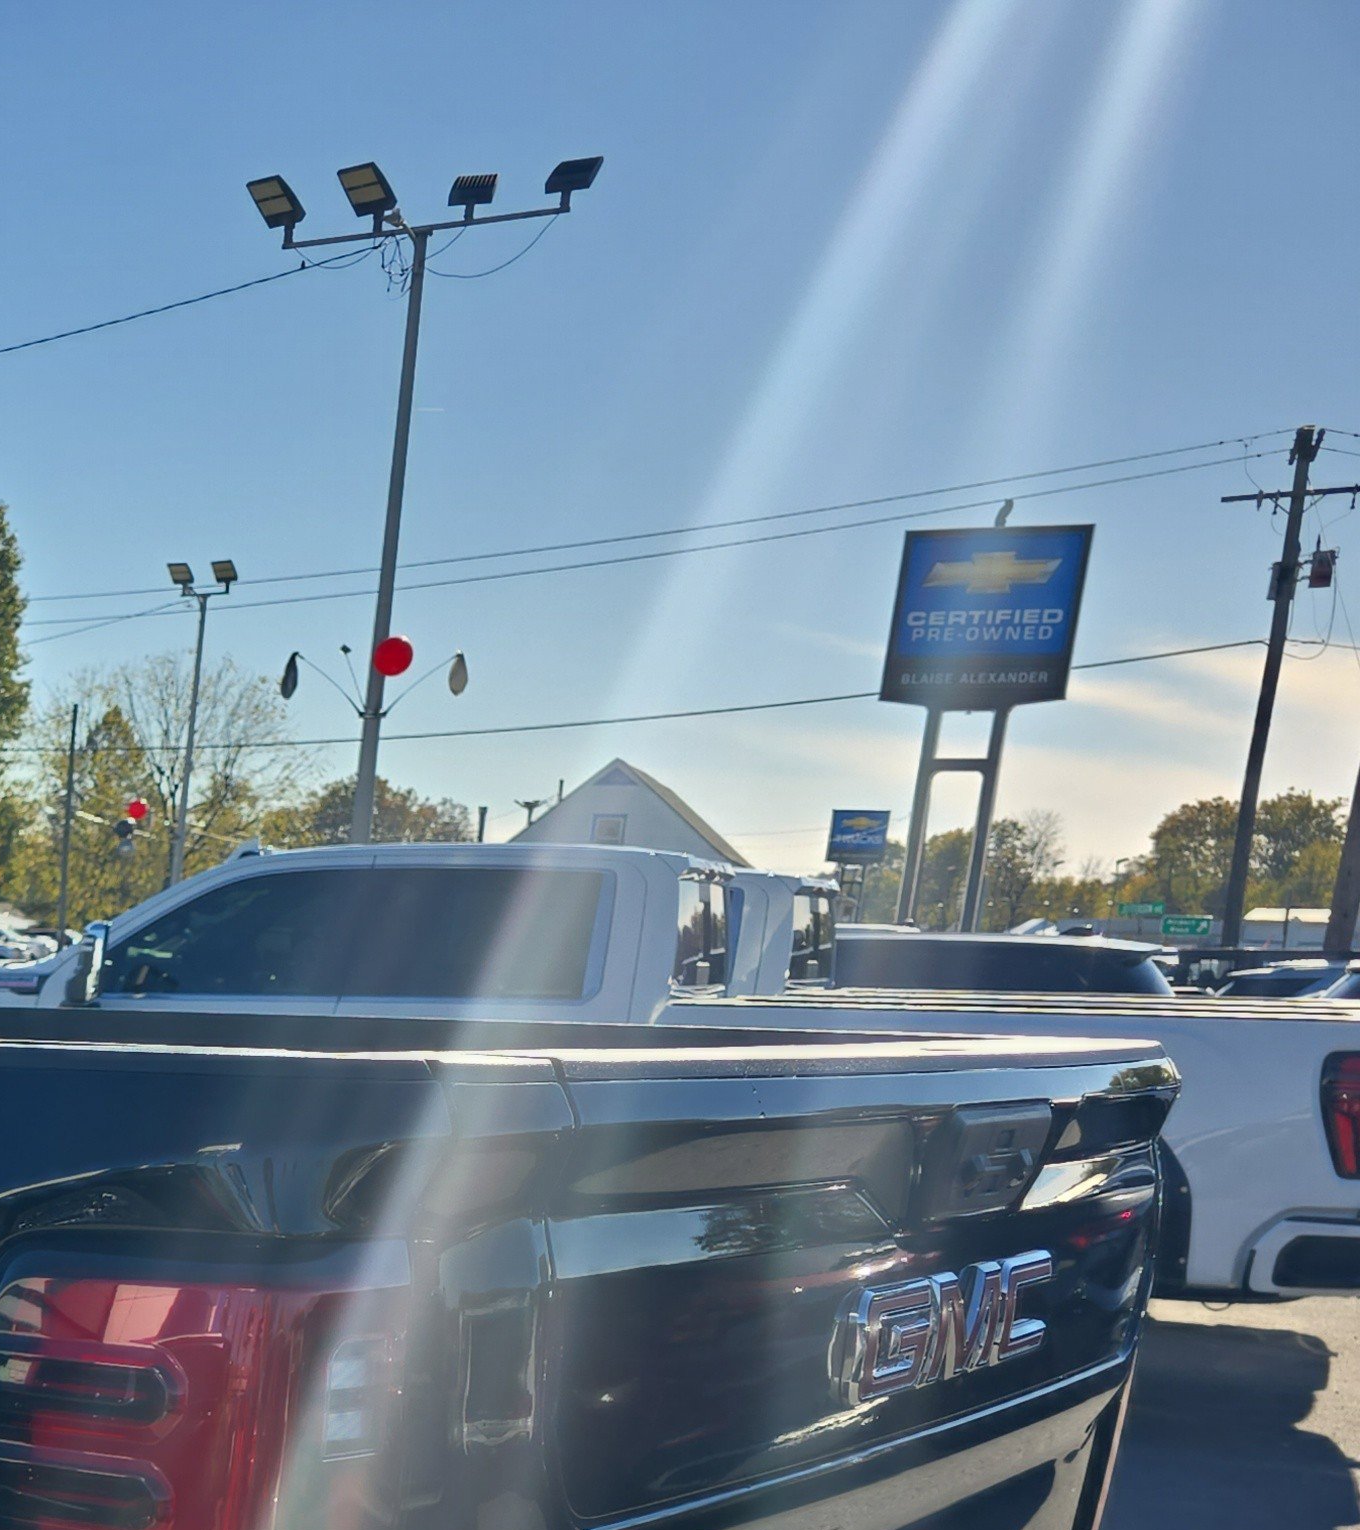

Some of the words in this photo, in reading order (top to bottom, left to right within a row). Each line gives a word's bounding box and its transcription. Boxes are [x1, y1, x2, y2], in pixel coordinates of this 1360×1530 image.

[907, 608, 1064, 626] CERTIFIED
[911, 626, 1053, 642] PRE-OWNED
[901, 672, 954, 685] BLAISE
[959, 671, 1048, 684] ALEXANDER
[828, 1249, 1053, 1405] GMC
